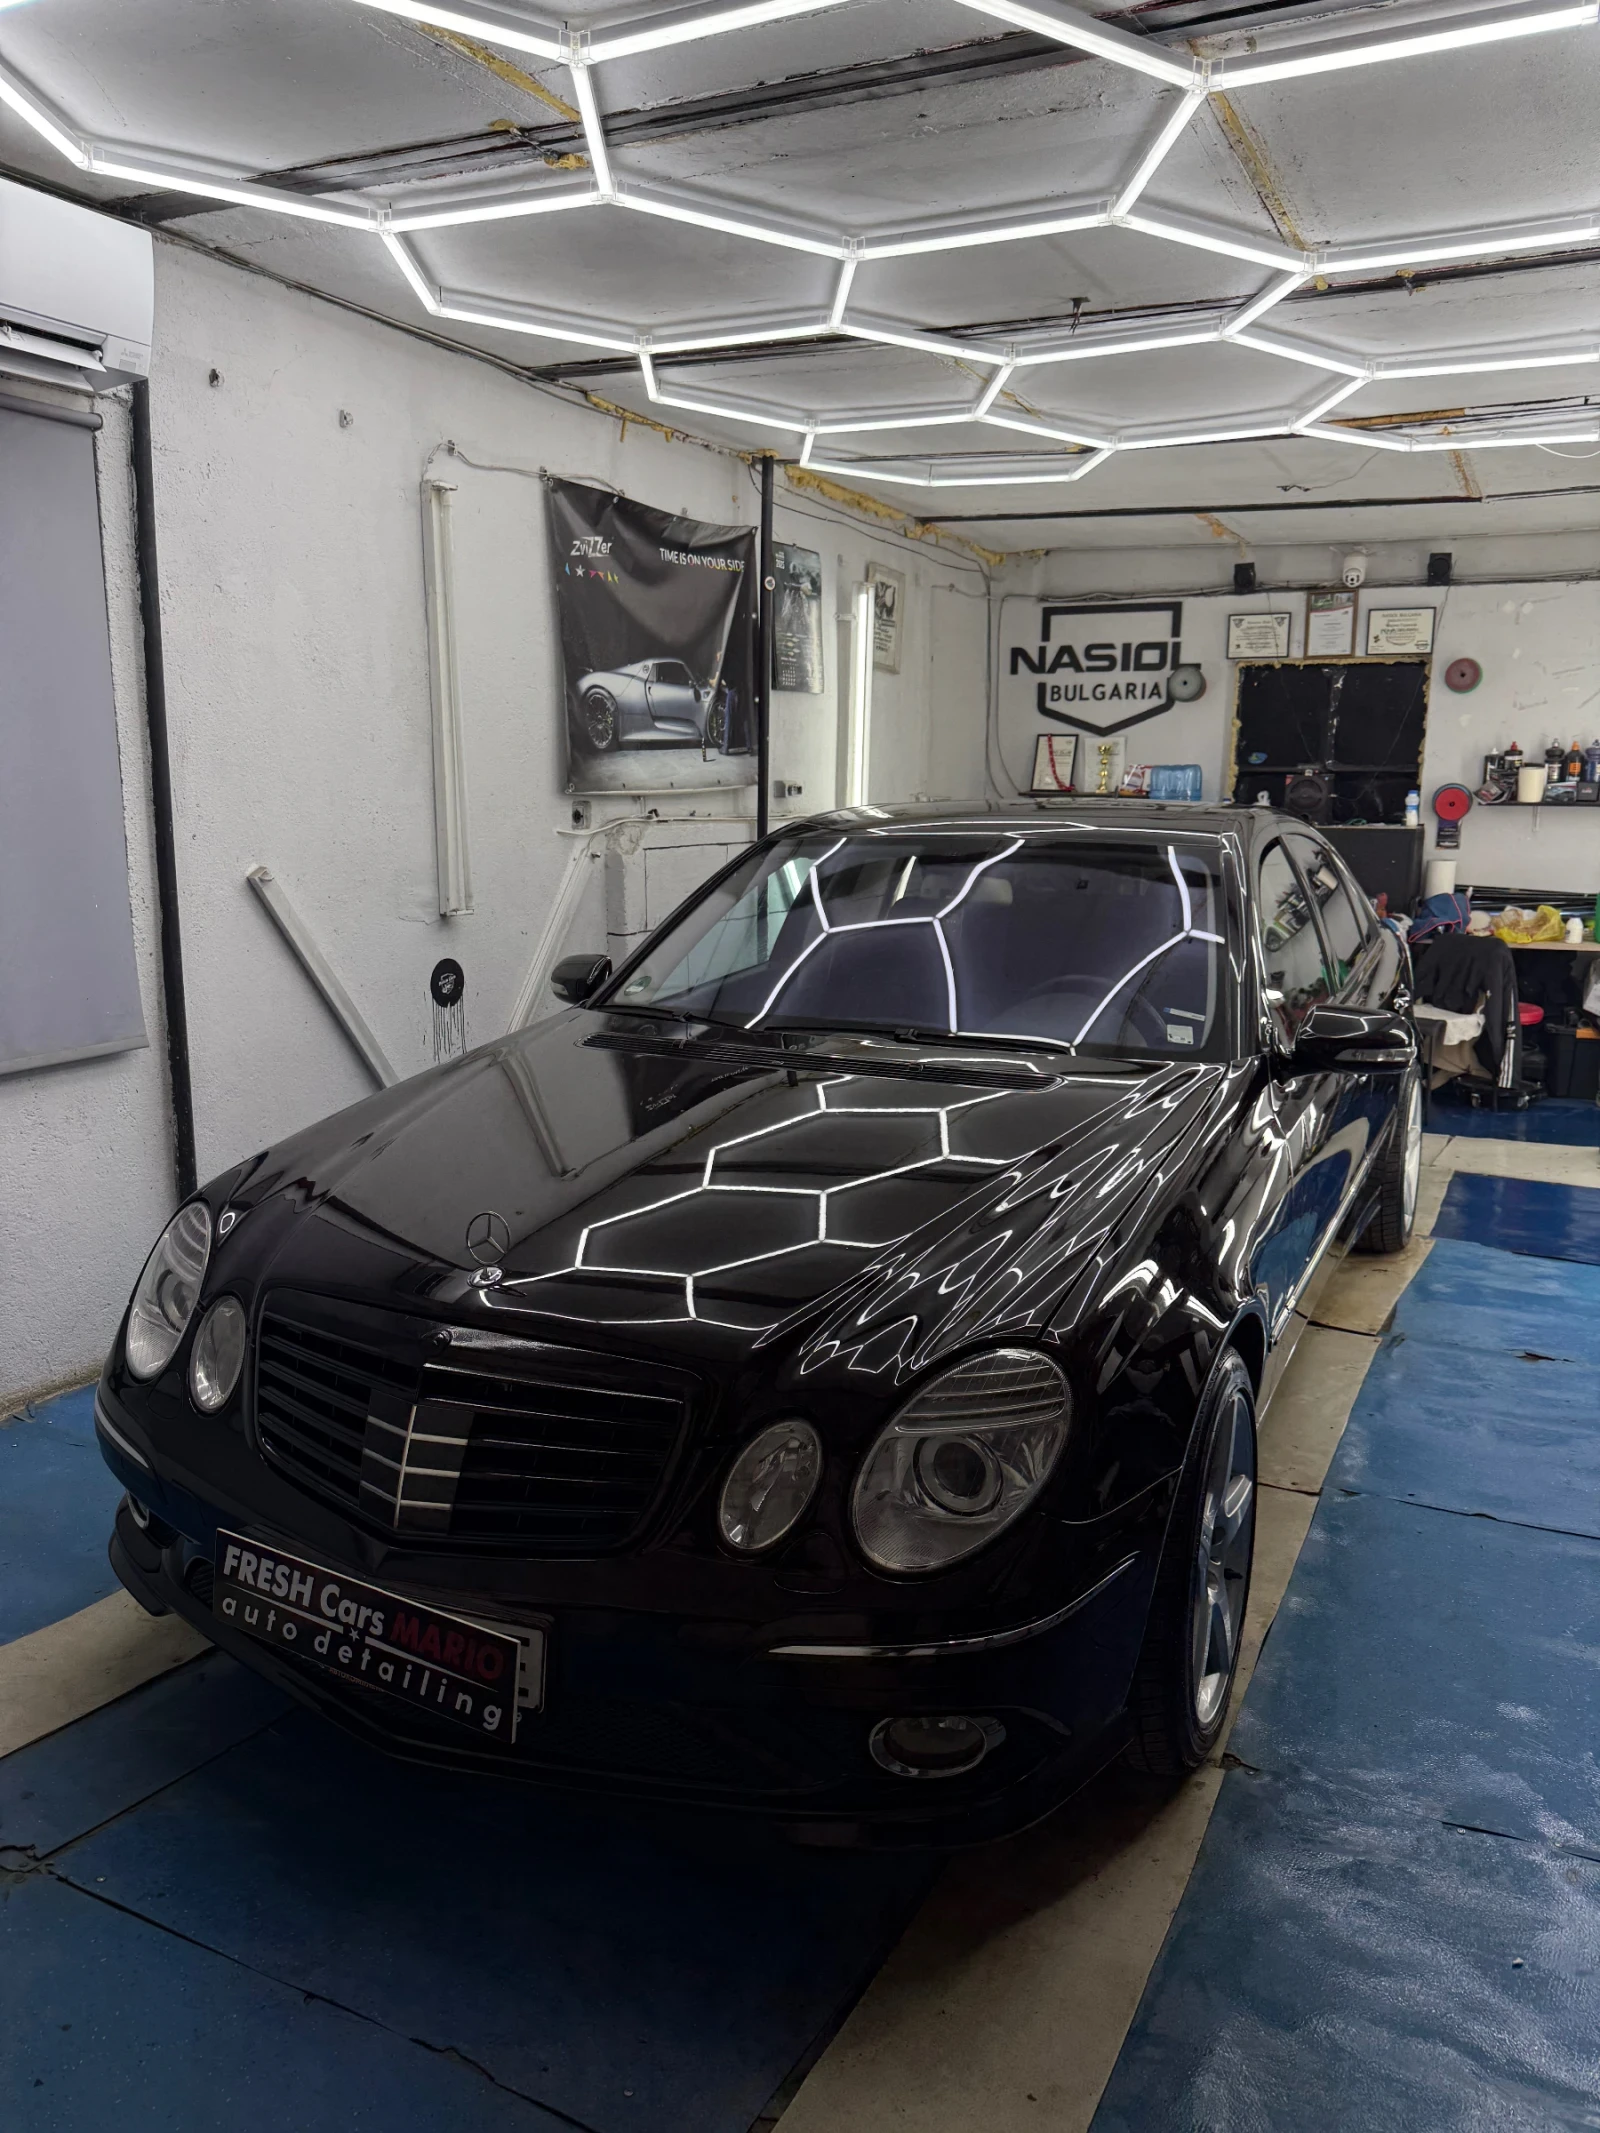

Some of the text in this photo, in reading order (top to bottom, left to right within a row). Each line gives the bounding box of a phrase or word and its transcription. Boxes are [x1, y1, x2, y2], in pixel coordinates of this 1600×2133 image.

[659, 547, 679, 564] TIME
[679, 552, 687, 565] IS
[687, 553, 700, 566] ON
[701, 556, 727, 571] YOUR
[1010, 640, 1202, 675] NASIOL
[1050, 681, 1163, 703] BULGARIA
[222, 1544, 315, 1608] FRESH
[319, 1582, 385, 1637] Cars
[389, 1611, 505, 1681] MARIO
[221, 1596, 299, 1641] auto
[313, 1630, 503, 1732] detailing
